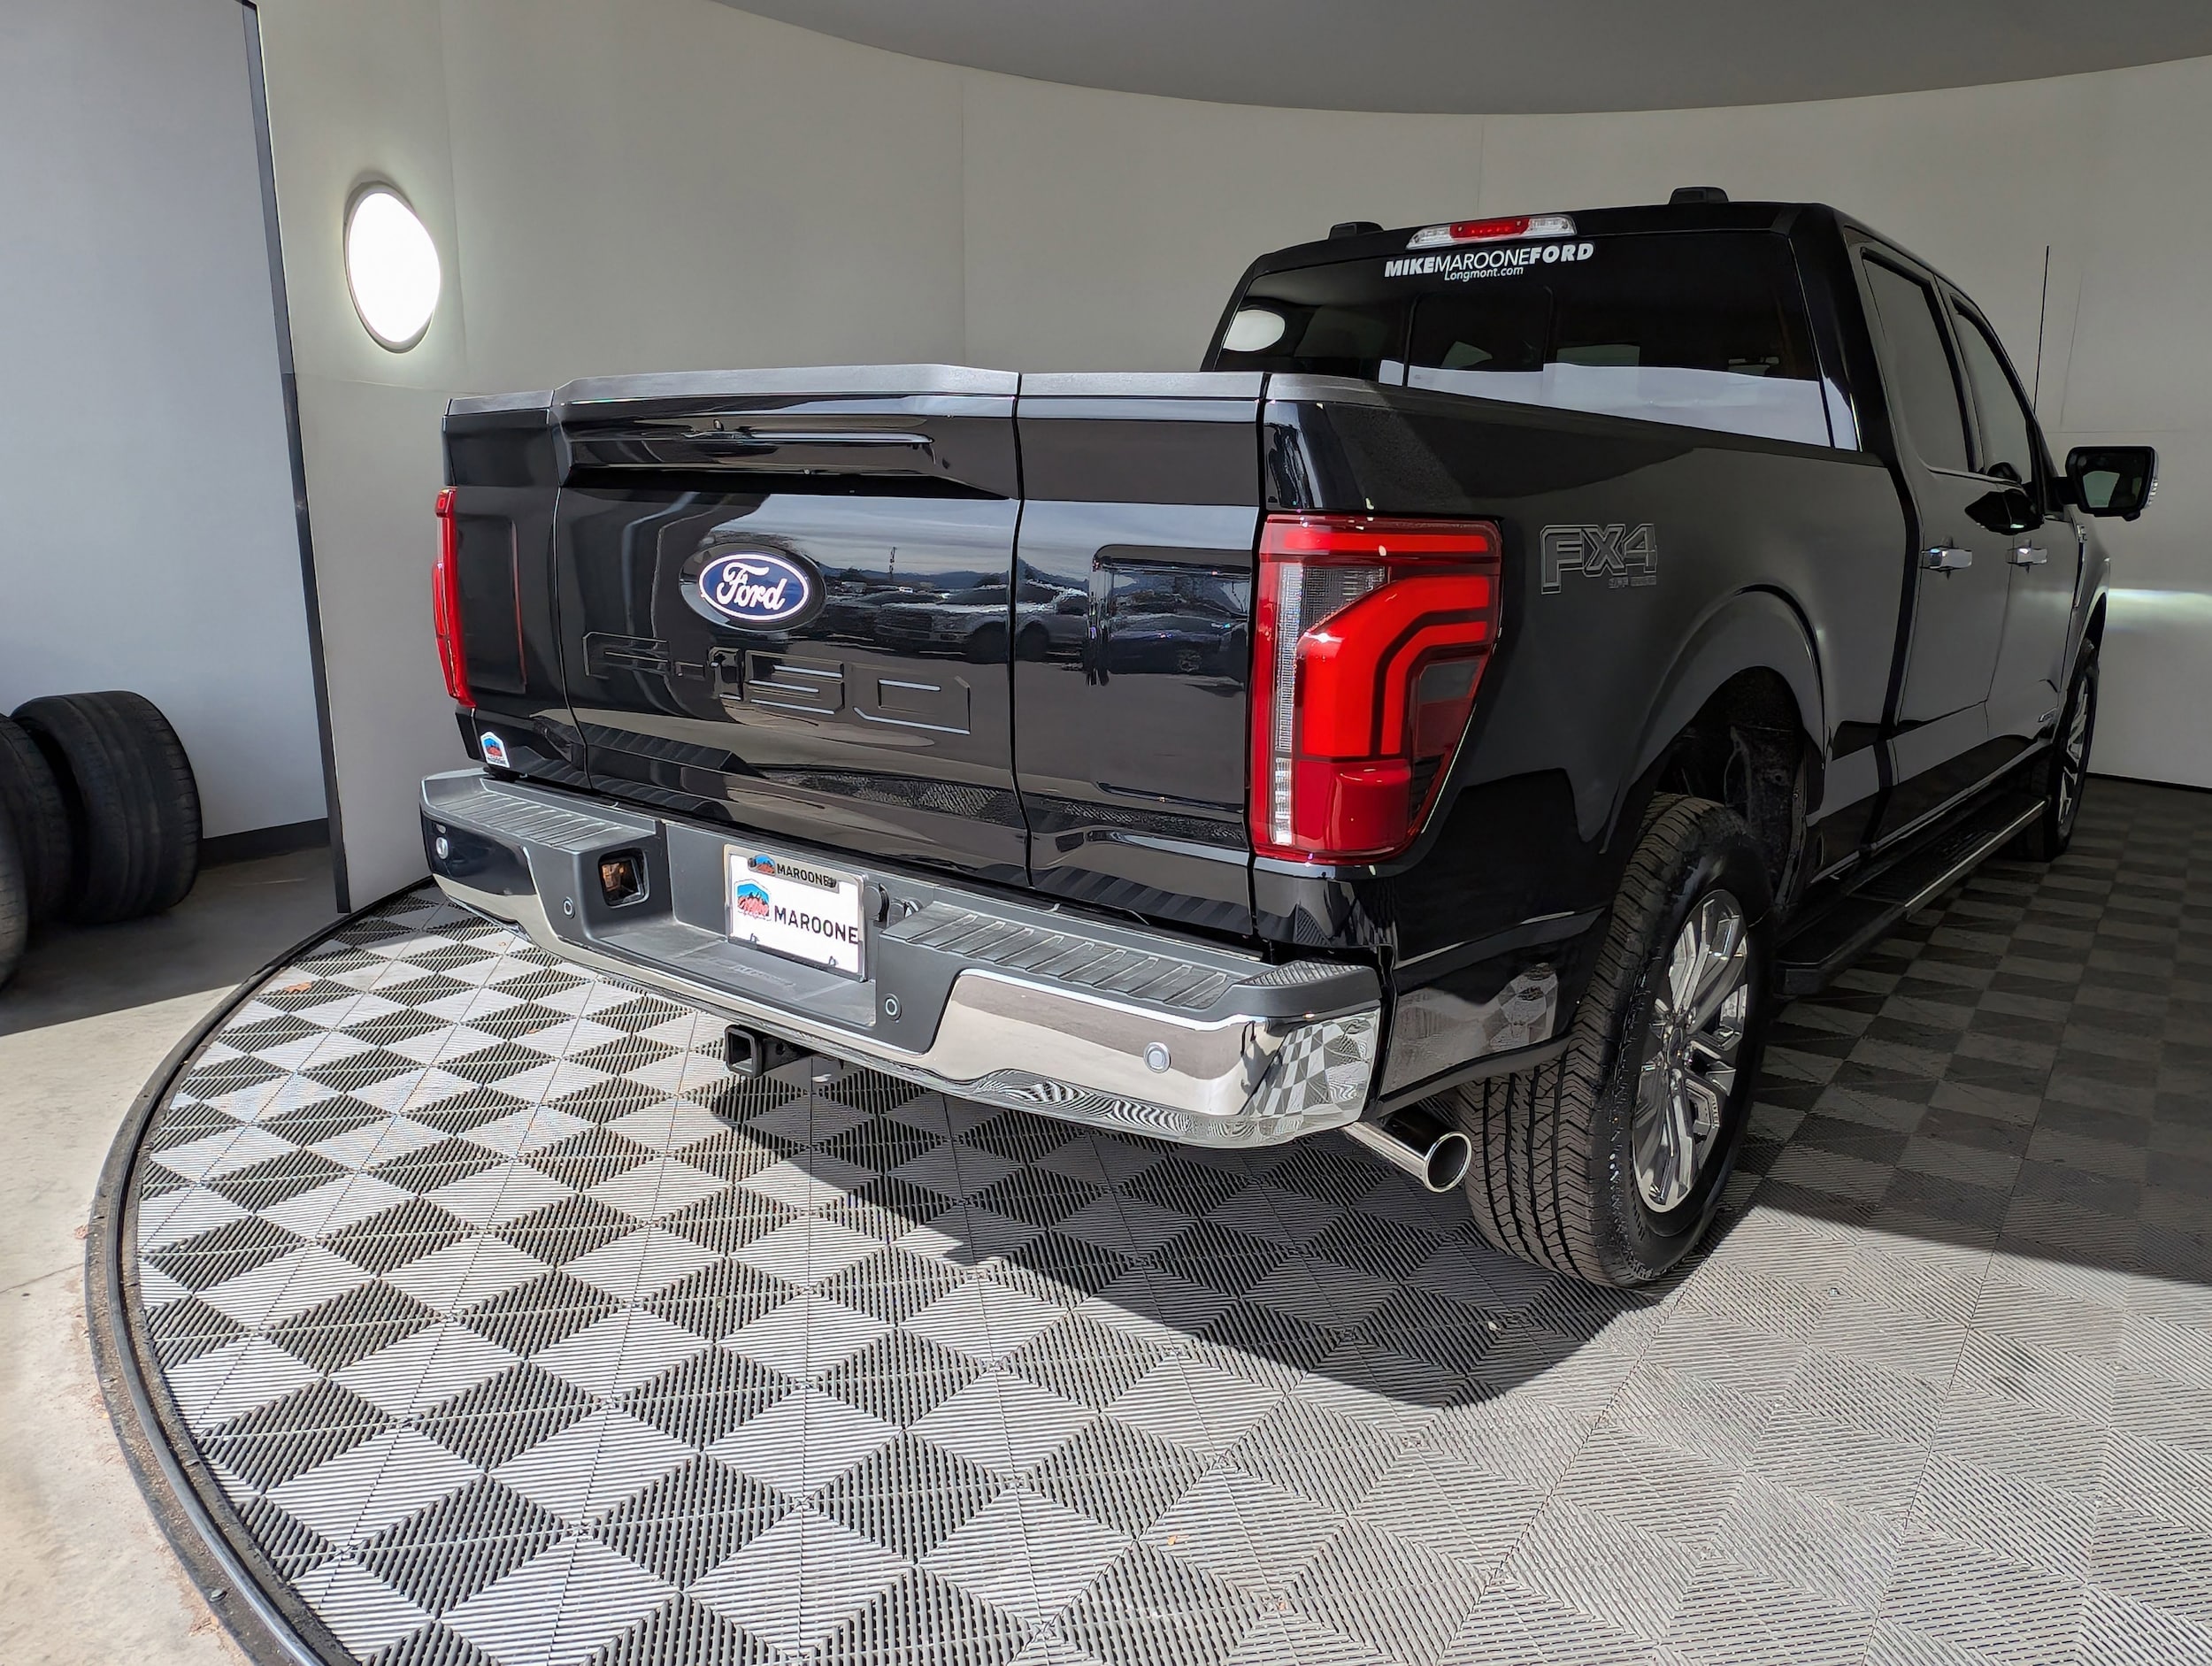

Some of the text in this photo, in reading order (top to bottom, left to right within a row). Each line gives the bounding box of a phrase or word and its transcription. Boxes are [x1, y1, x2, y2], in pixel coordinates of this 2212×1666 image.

[1444, 263, 1524, 282] Longmont.com
[1540, 523, 1657, 595] FX4
[717, 561, 787, 610] Ford
[774, 905, 859, 944] MAROONE
